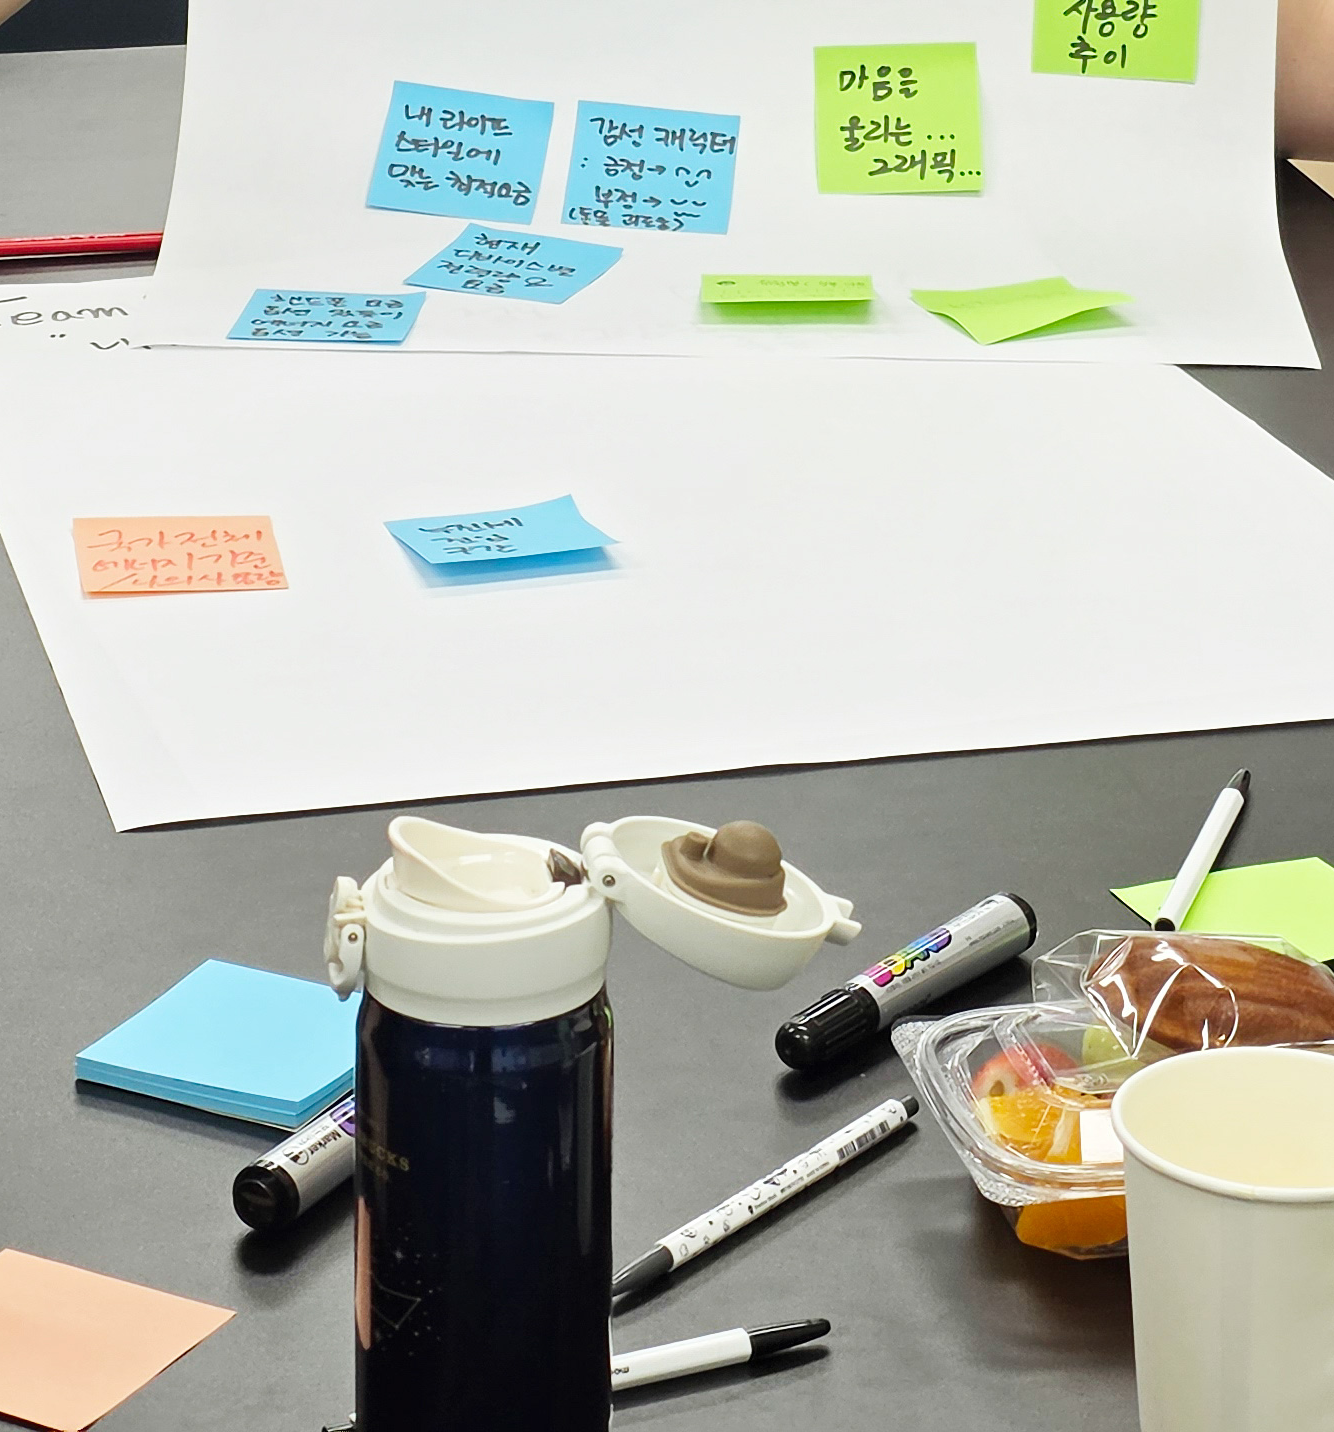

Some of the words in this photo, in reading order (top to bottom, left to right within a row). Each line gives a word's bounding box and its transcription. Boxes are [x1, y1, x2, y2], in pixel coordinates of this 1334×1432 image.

[1069, 35, 1127, 73] 추이
[839, 64, 918, 101] 마음을
[404, 104, 432, 127] 내
[395, 130, 501, 165] 스타일에
